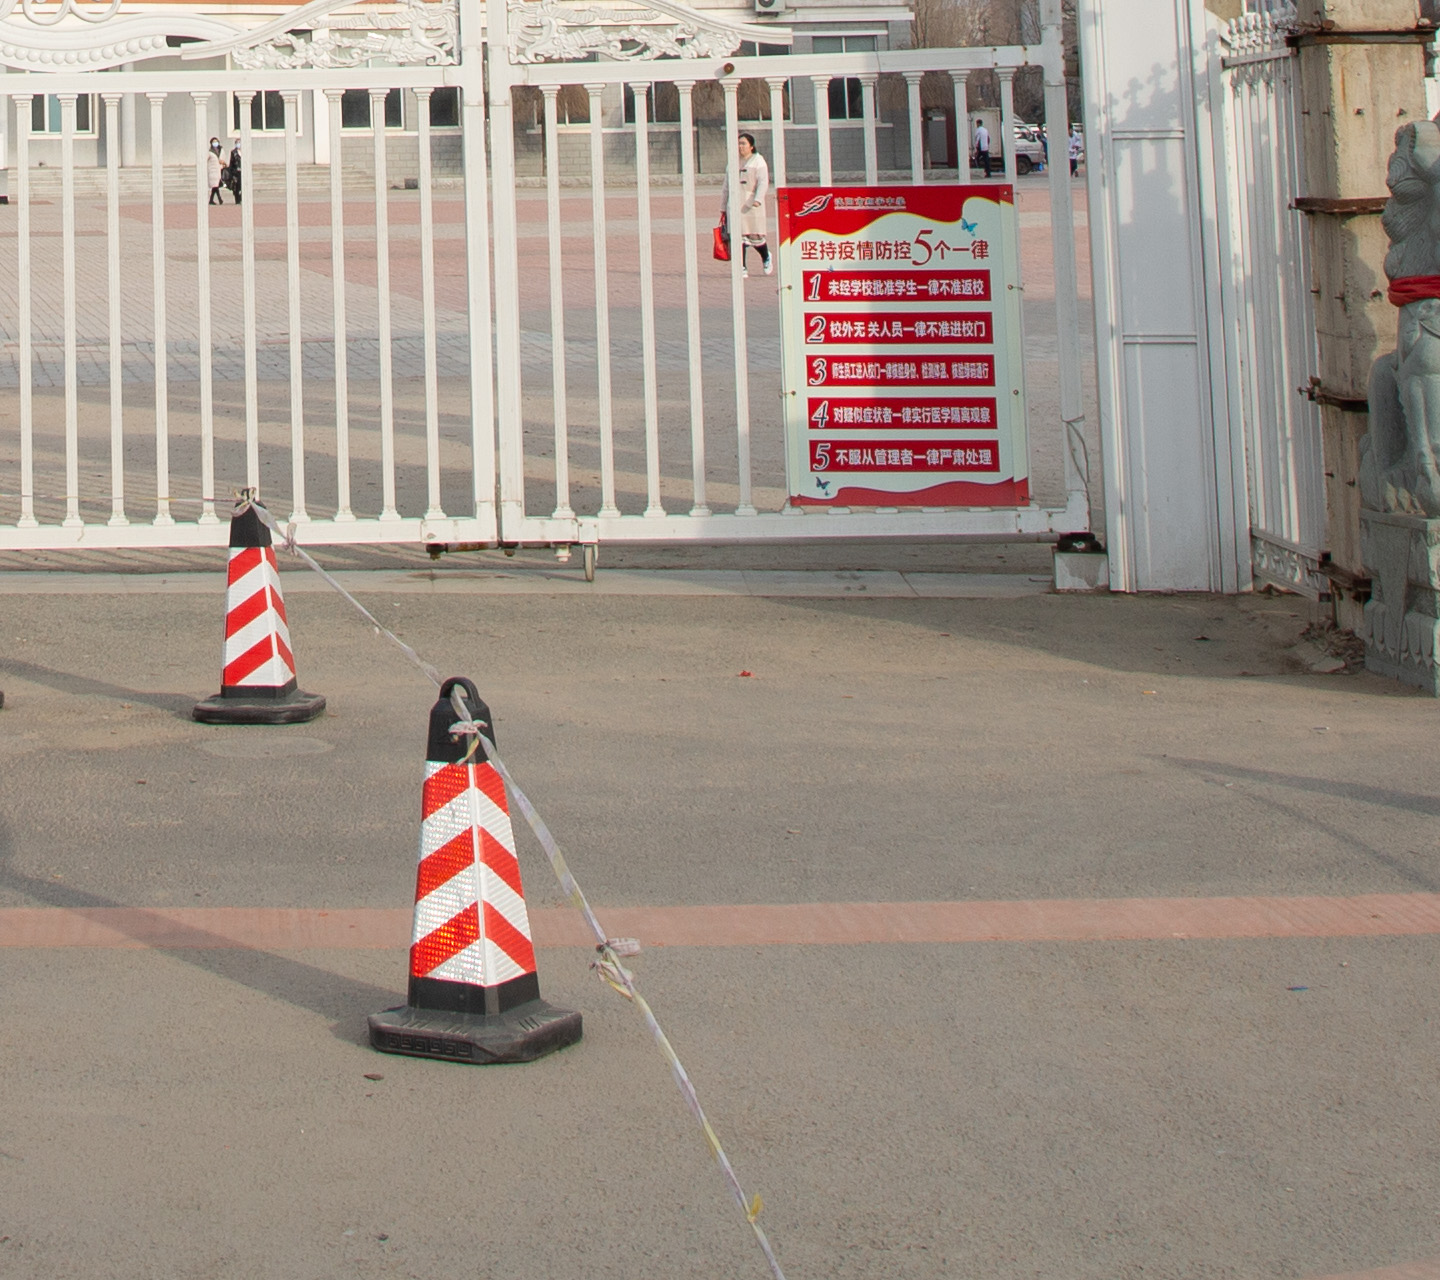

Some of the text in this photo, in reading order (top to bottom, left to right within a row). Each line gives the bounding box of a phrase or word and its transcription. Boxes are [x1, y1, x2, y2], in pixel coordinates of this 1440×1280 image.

[801, 230, 989, 266] 坚持疫情防控5个一律
[807, 273, 985, 301] 1 未经学校批准学生一律不准返校
[806, 316, 827, 343] 2
[809, 357, 827, 385] 3
[811, 400, 829, 428] 4
[812, 443, 992, 471] 5 不服从管理者一律严肃处理
